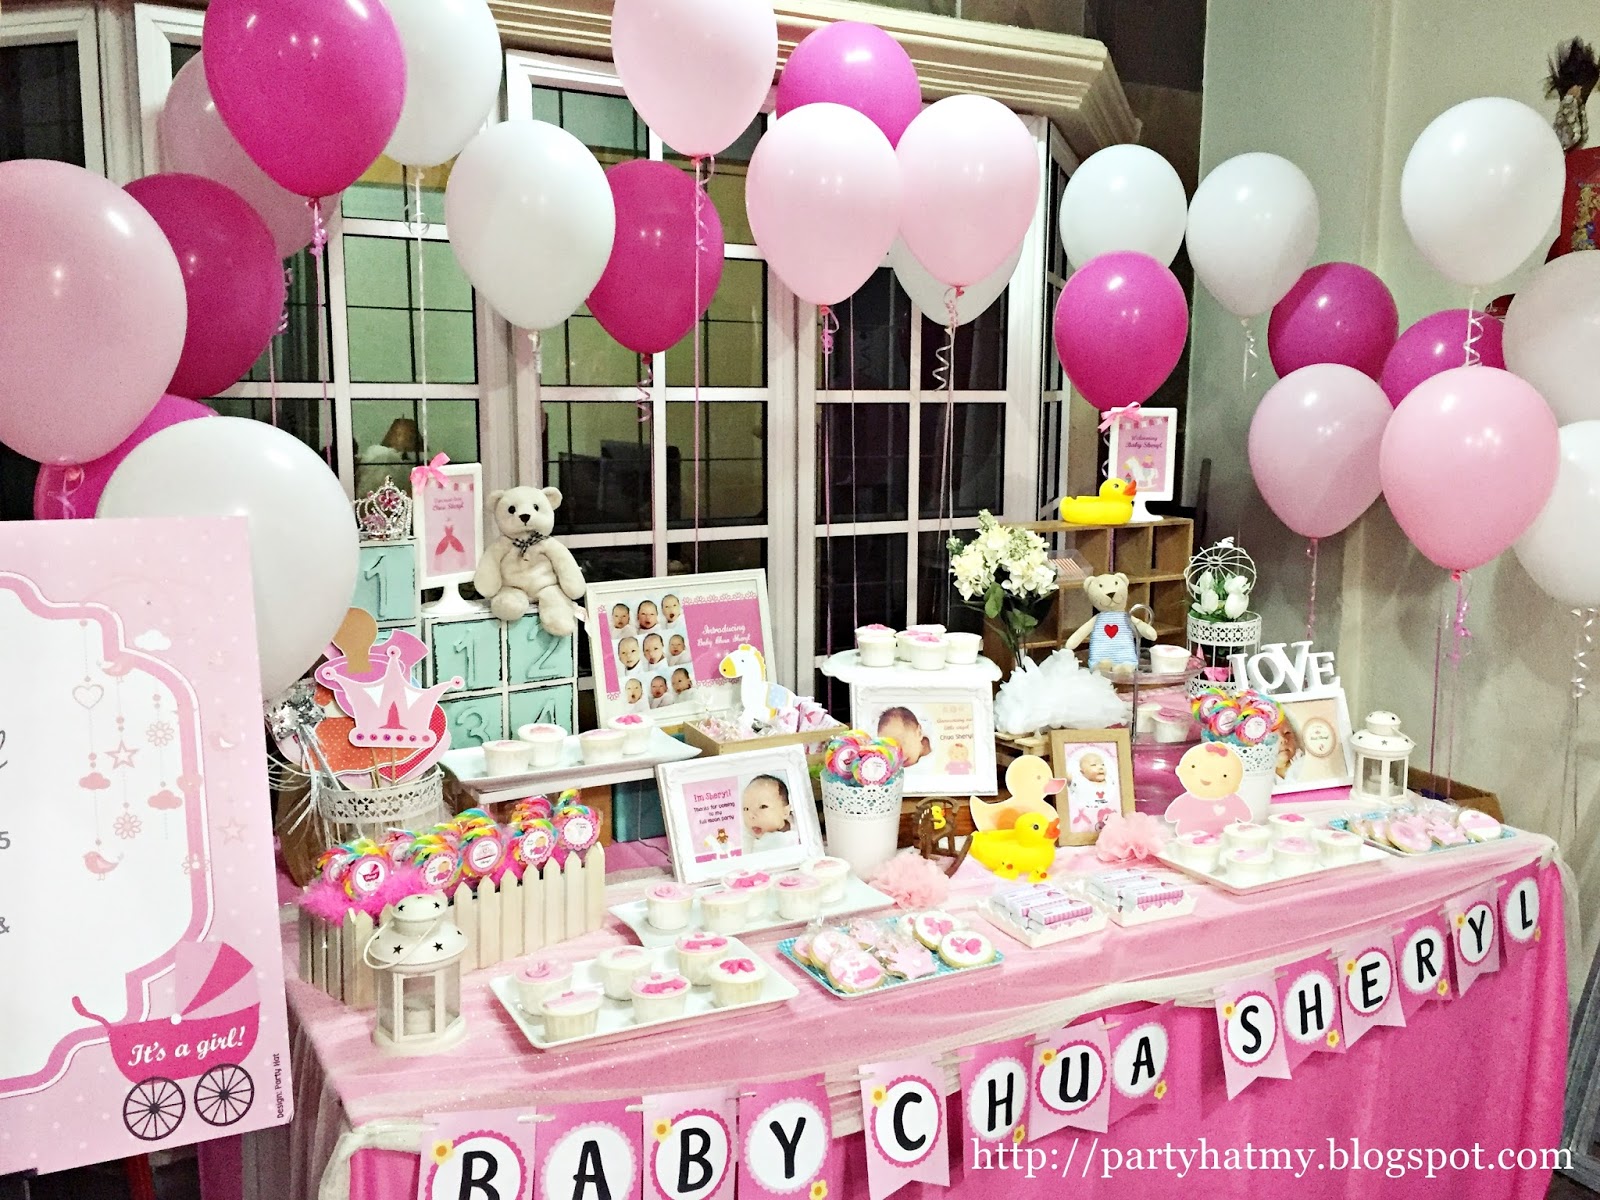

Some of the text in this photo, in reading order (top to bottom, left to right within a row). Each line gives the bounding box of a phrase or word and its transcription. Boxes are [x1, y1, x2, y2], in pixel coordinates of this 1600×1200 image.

[453, 627, 476, 690] 1
[701, 624, 746, 635] Introducing
[128, 1025, 246, 1067] It's a girl!
[458, 889, 1534, 1200] BABY CHUA SHERYL
[272, 1053, 285, 1119] Design: Party Hat
